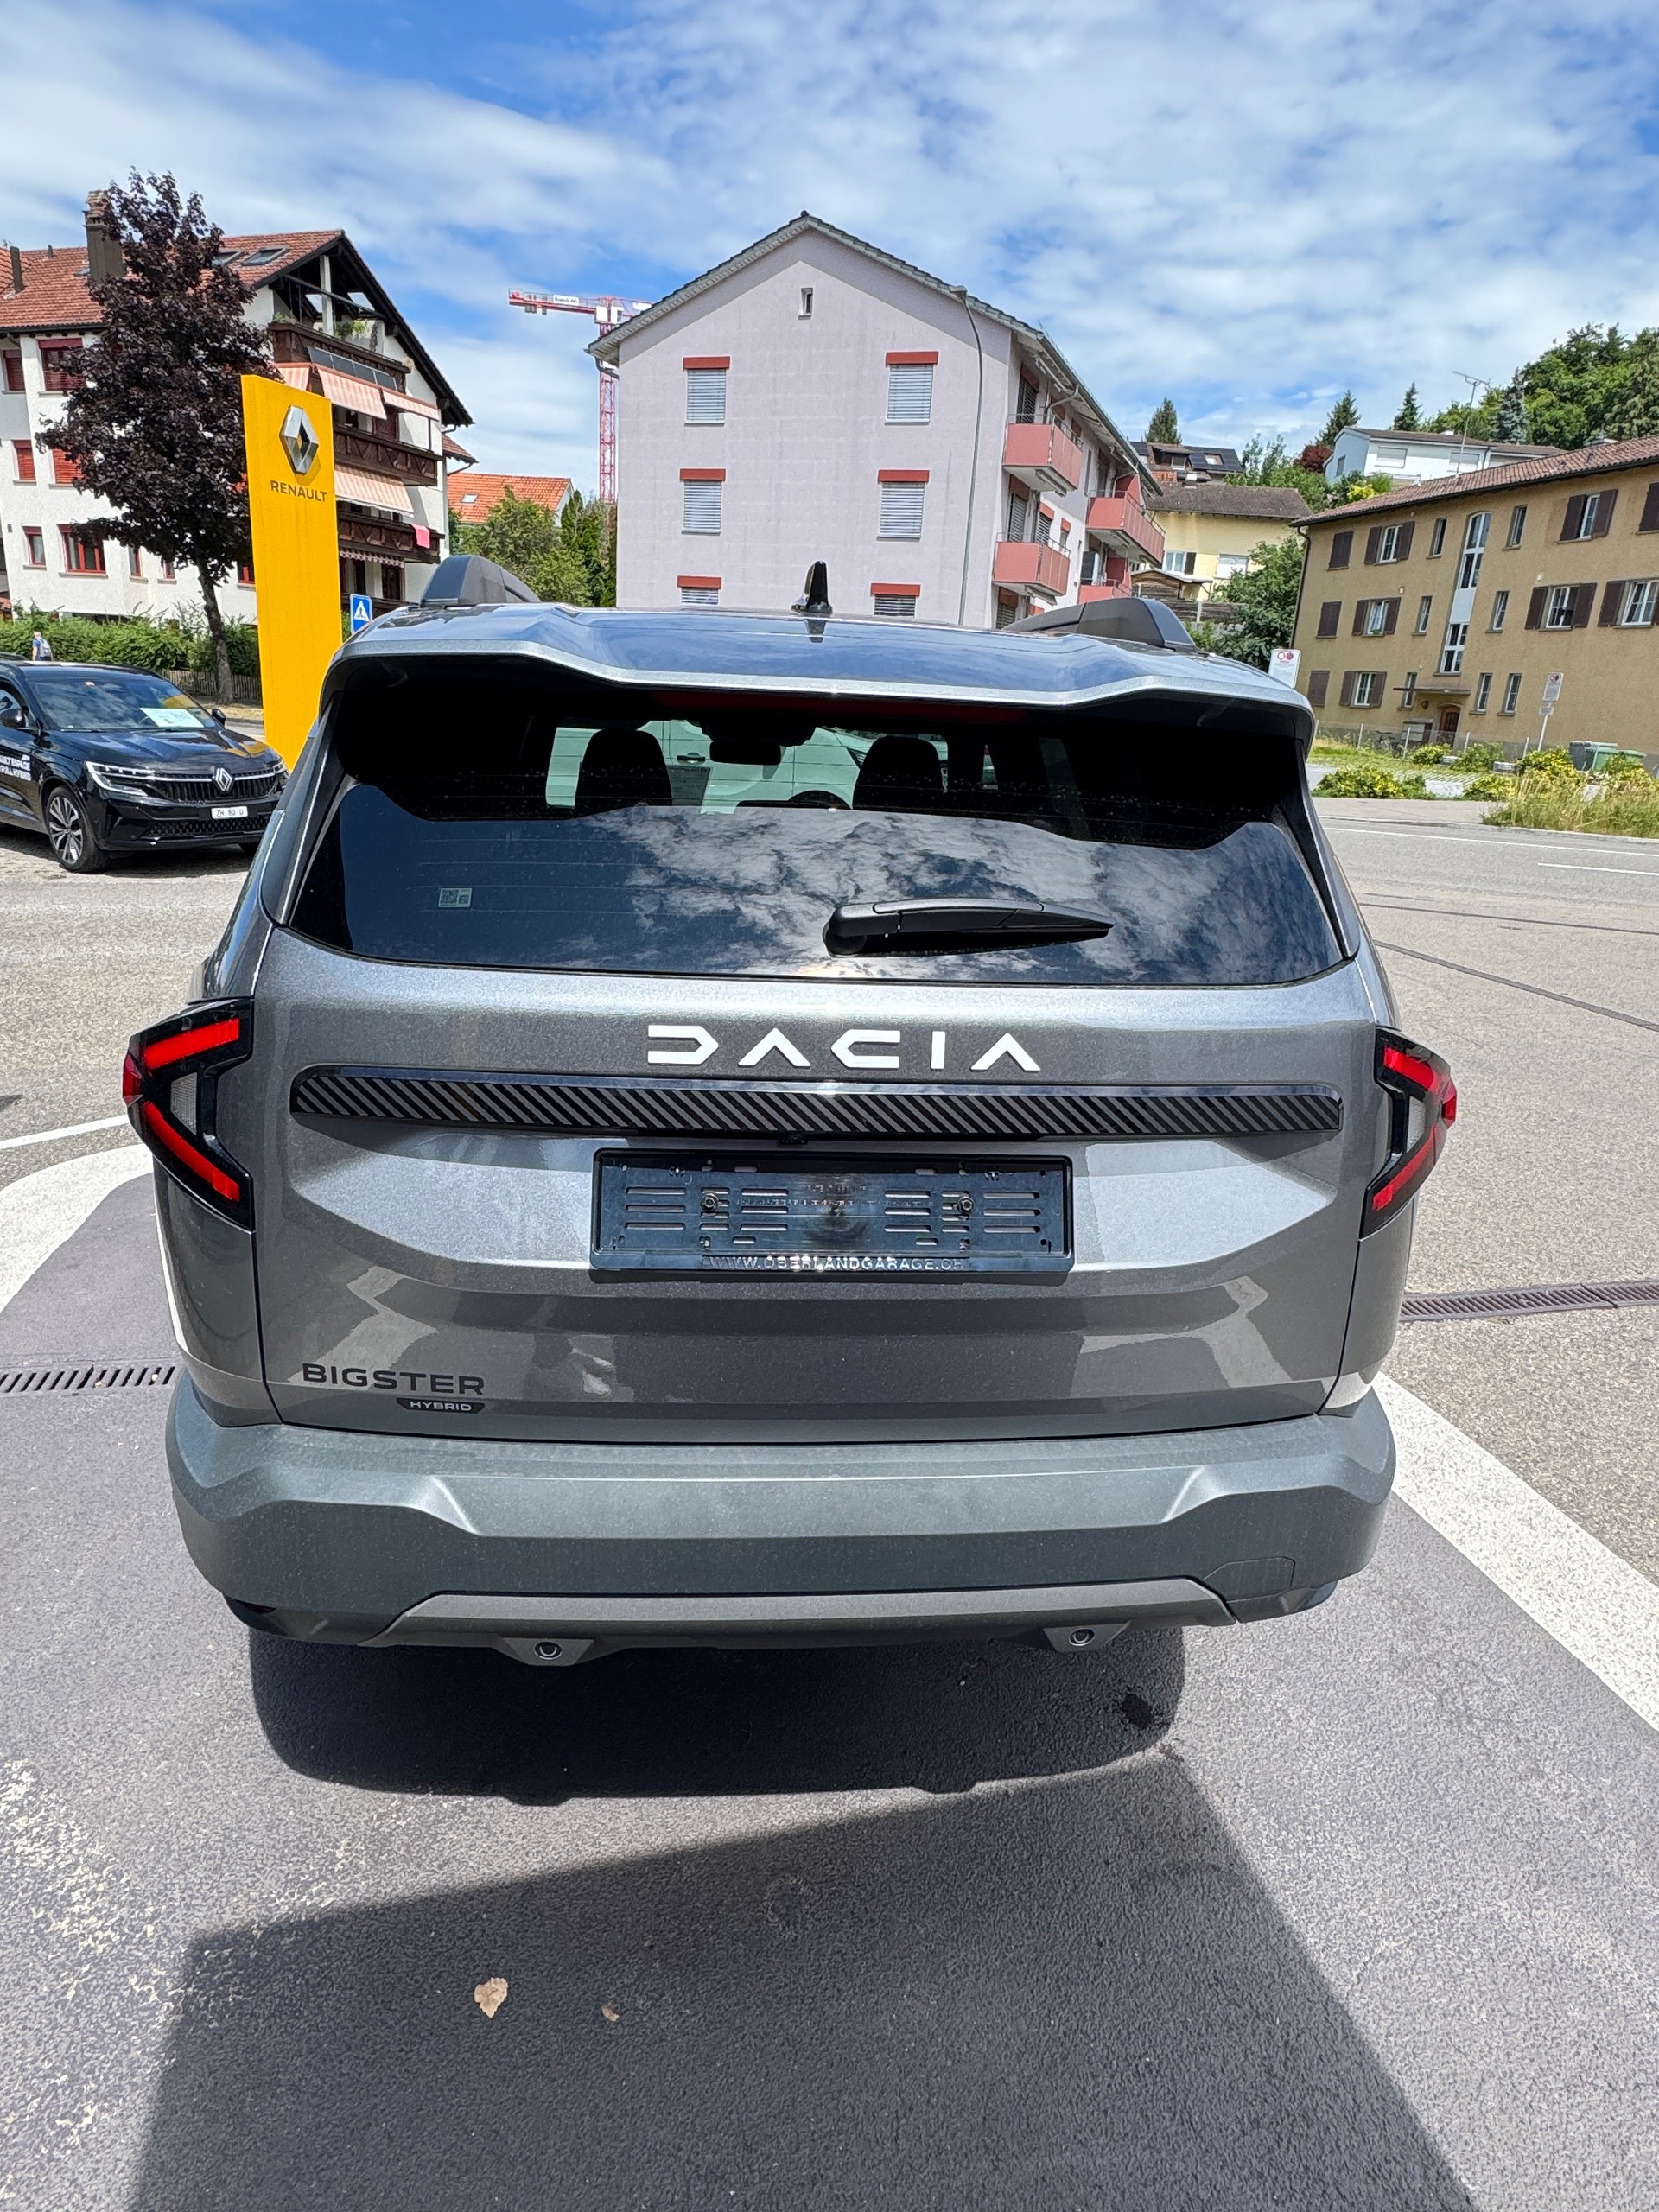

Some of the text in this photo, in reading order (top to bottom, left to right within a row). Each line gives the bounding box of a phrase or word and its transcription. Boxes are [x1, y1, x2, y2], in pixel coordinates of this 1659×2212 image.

[270, 480, 327, 502] RENAULT
[647, 1024, 1041, 1071] DACIA
[709, 1255, 963, 1271] WWW.OBERLANDGARAGE.CH
[302, 1363, 485, 1395] BIGSTER
[410, 1400, 472, 1412] HYBRID
